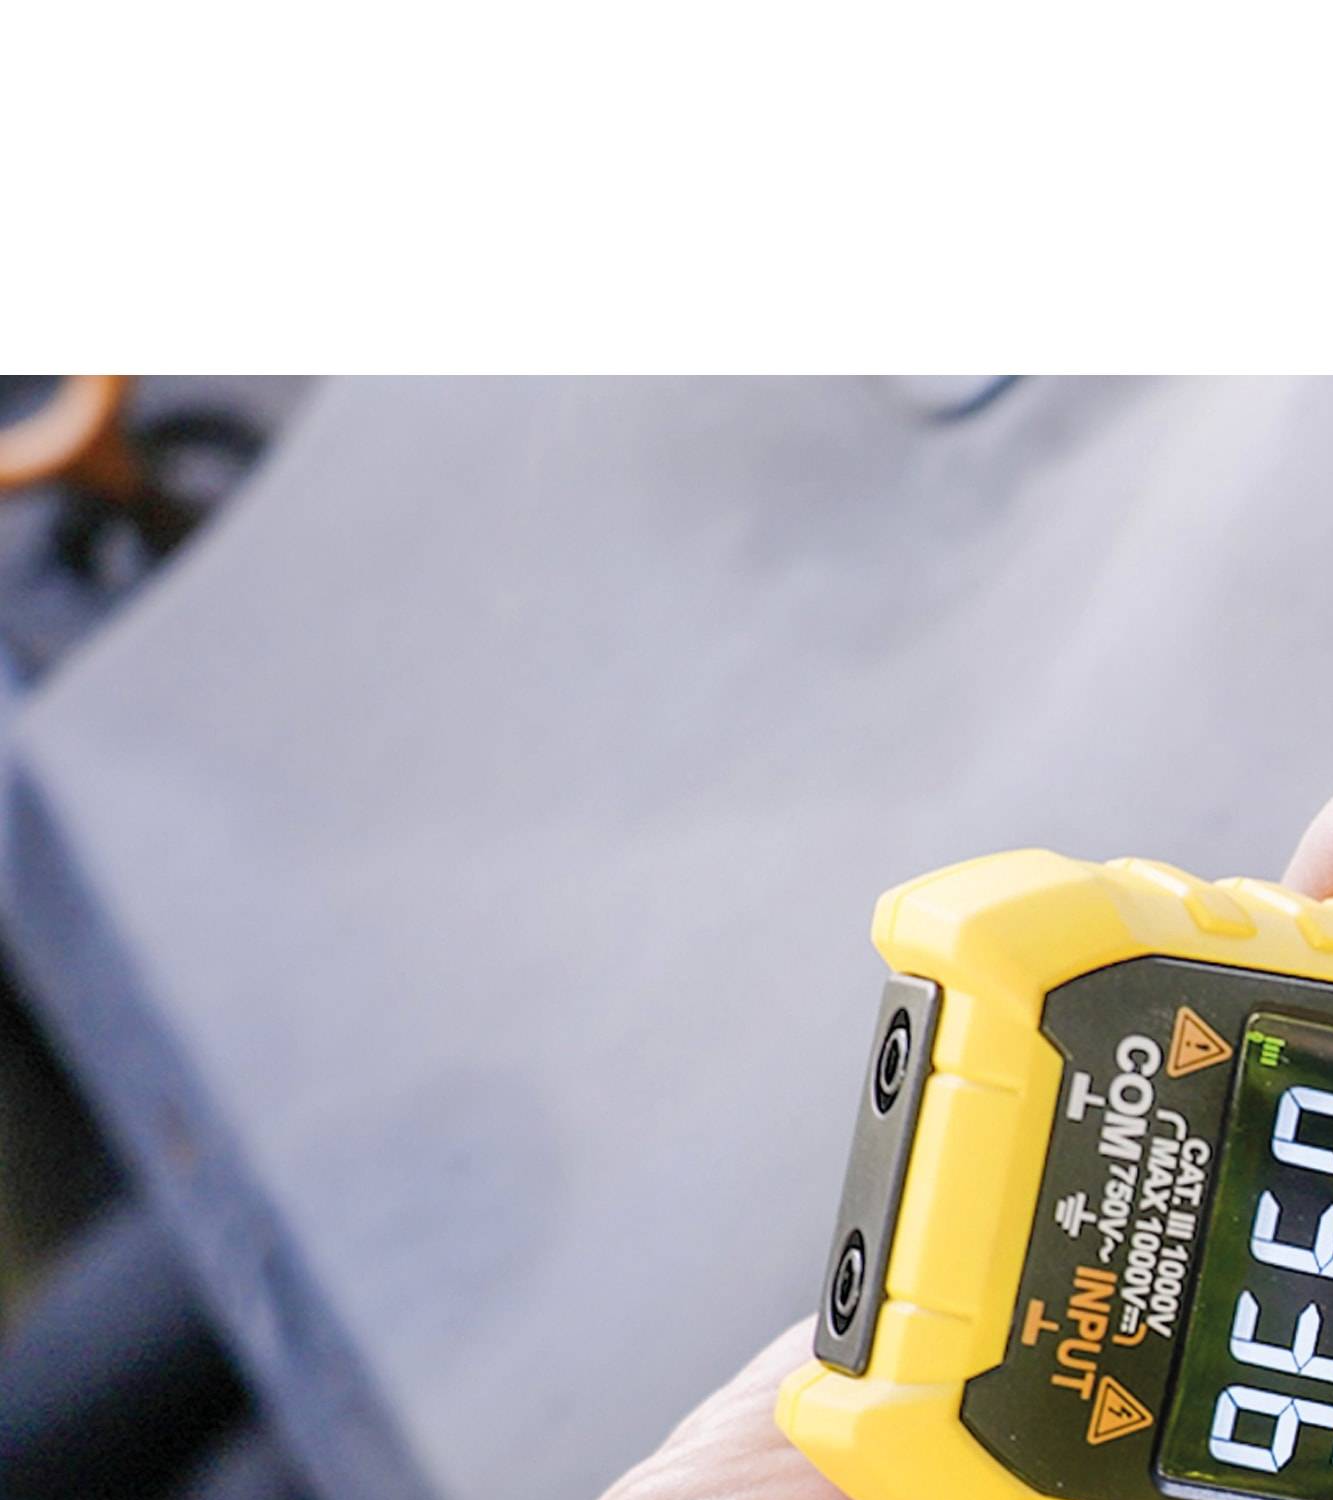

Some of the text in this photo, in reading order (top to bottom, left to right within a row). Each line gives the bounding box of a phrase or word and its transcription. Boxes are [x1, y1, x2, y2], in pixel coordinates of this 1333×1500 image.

[1098, 1035, 1161, 1161] COM
[1139, 1136, 1180, 1213] MAX
[1146, 1133, 1210, 1337] CAT. III 1000V
[1051, 1267, 1116, 1400] INPUT
